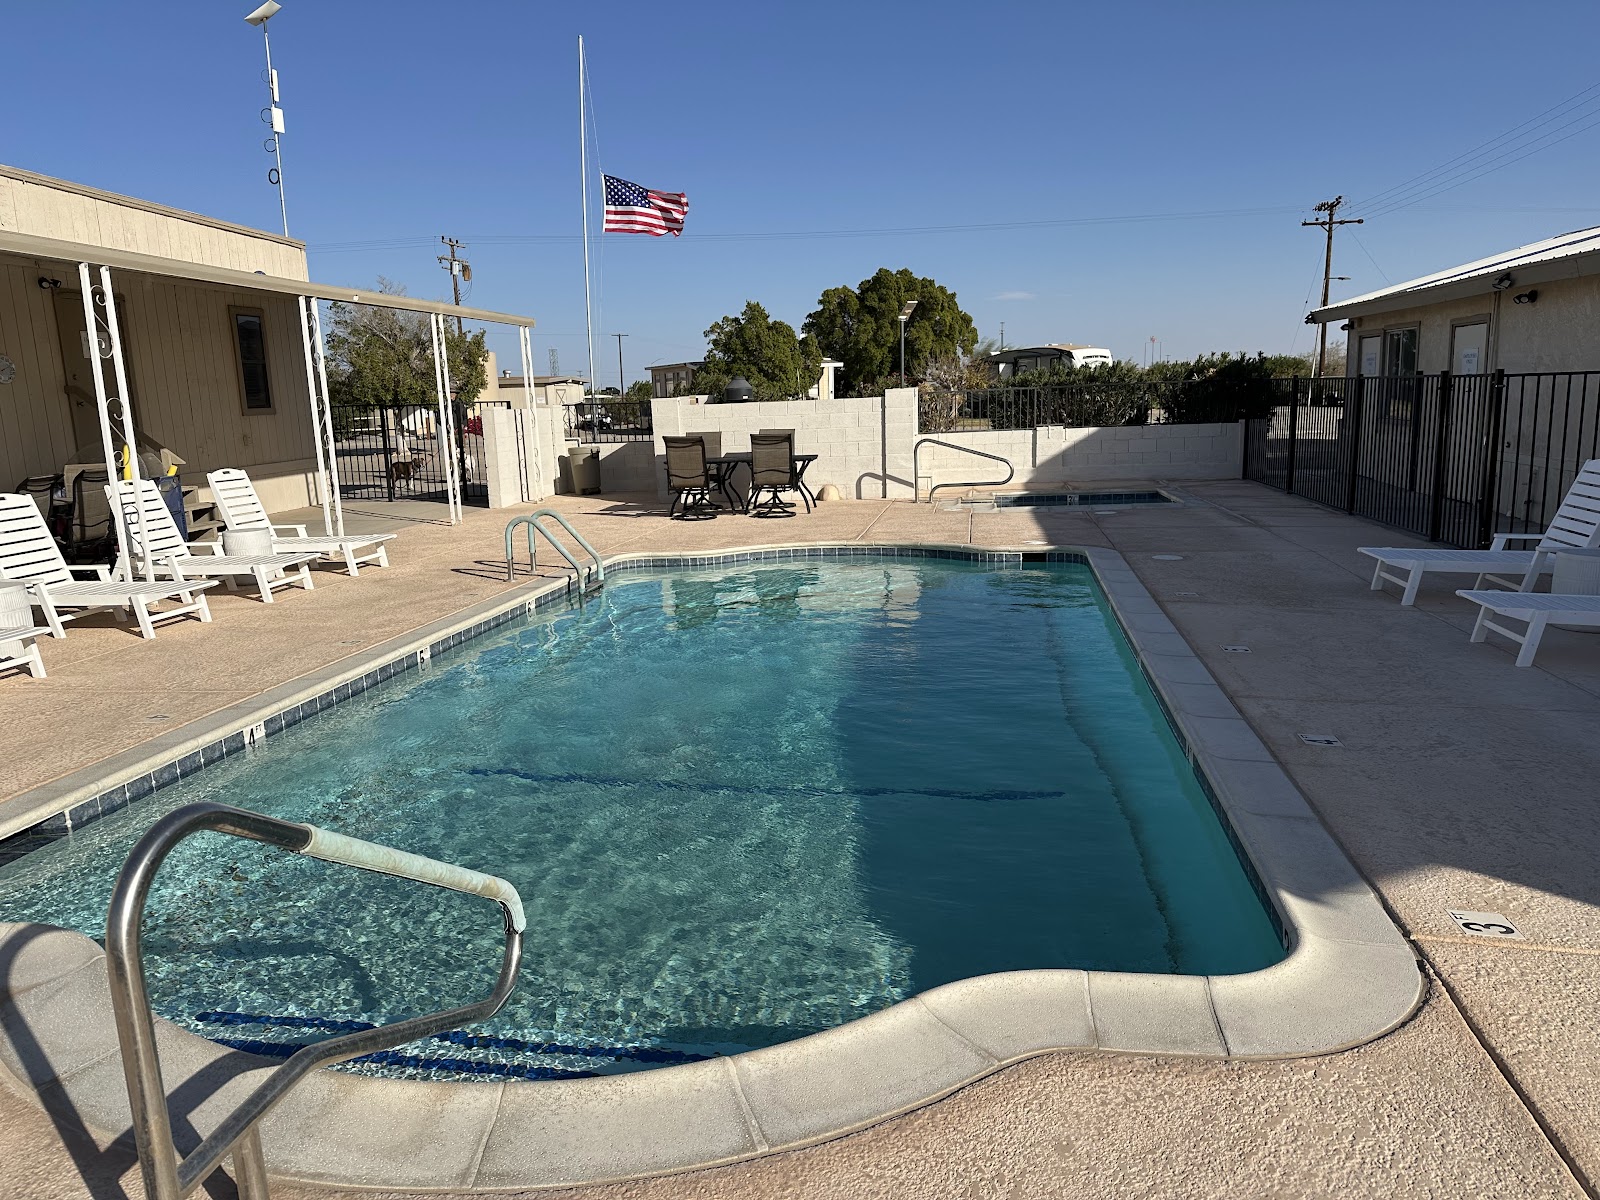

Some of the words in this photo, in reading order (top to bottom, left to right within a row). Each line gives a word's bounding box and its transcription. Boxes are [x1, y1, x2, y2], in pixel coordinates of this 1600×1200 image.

[420, 649, 425, 664] 5
[1450, 911, 1470, 921] FT
[1461, 922, 1515, 935] 3
